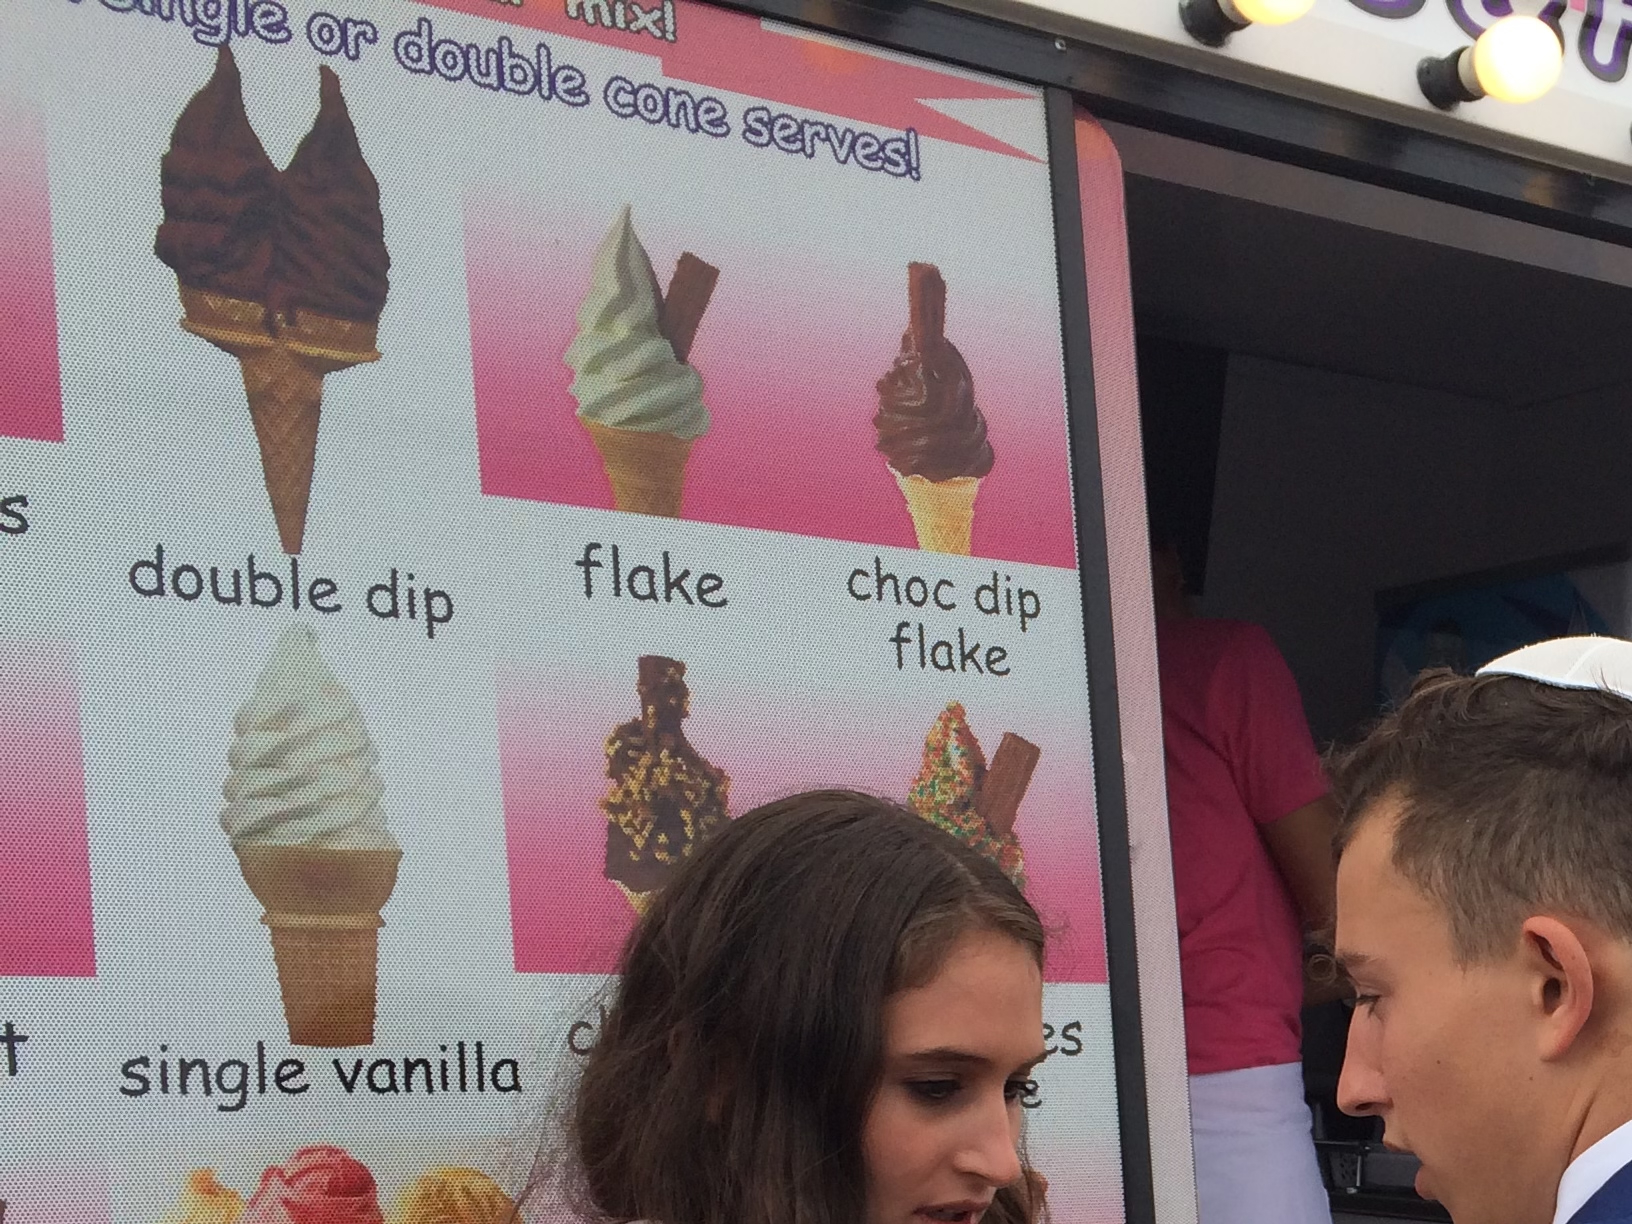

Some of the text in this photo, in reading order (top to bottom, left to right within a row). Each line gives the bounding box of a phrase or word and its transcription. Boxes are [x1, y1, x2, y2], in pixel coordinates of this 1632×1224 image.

[305, 12, 378, 60] or
[393, 17, 590, 107] double
[602, 76, 731, 137] cone
[742, 106, 922, 180] serves!
[129, 543, 455, 639] double dip
[575, 542, 728, 608] flake
[847, 556, 1042, 632] choc dip
[889, 622, 1011, 677] flake
[119, 1040, 523, 1112] single vanilla
